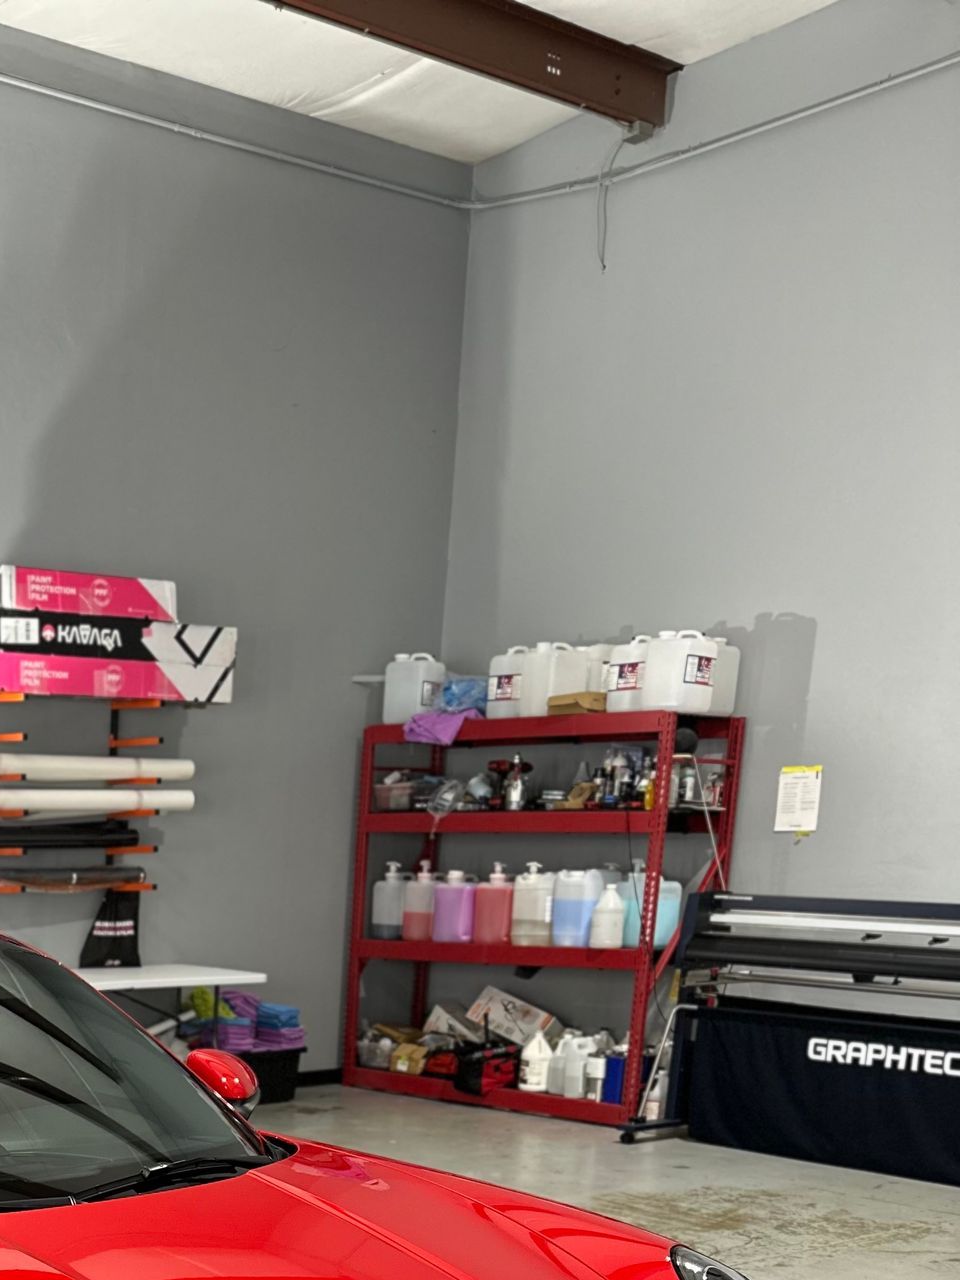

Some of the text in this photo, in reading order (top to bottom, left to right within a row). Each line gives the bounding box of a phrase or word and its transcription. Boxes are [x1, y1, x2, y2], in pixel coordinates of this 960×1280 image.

[29, 575, 53, 584] PAINT
[29, 584, 77, 596] PROTECTION
[29, 593, 49, 602] FILM
[22, 669, 70, 680] PROTECTION
[807, 1037, 960, 1077] GRAPHTEC
